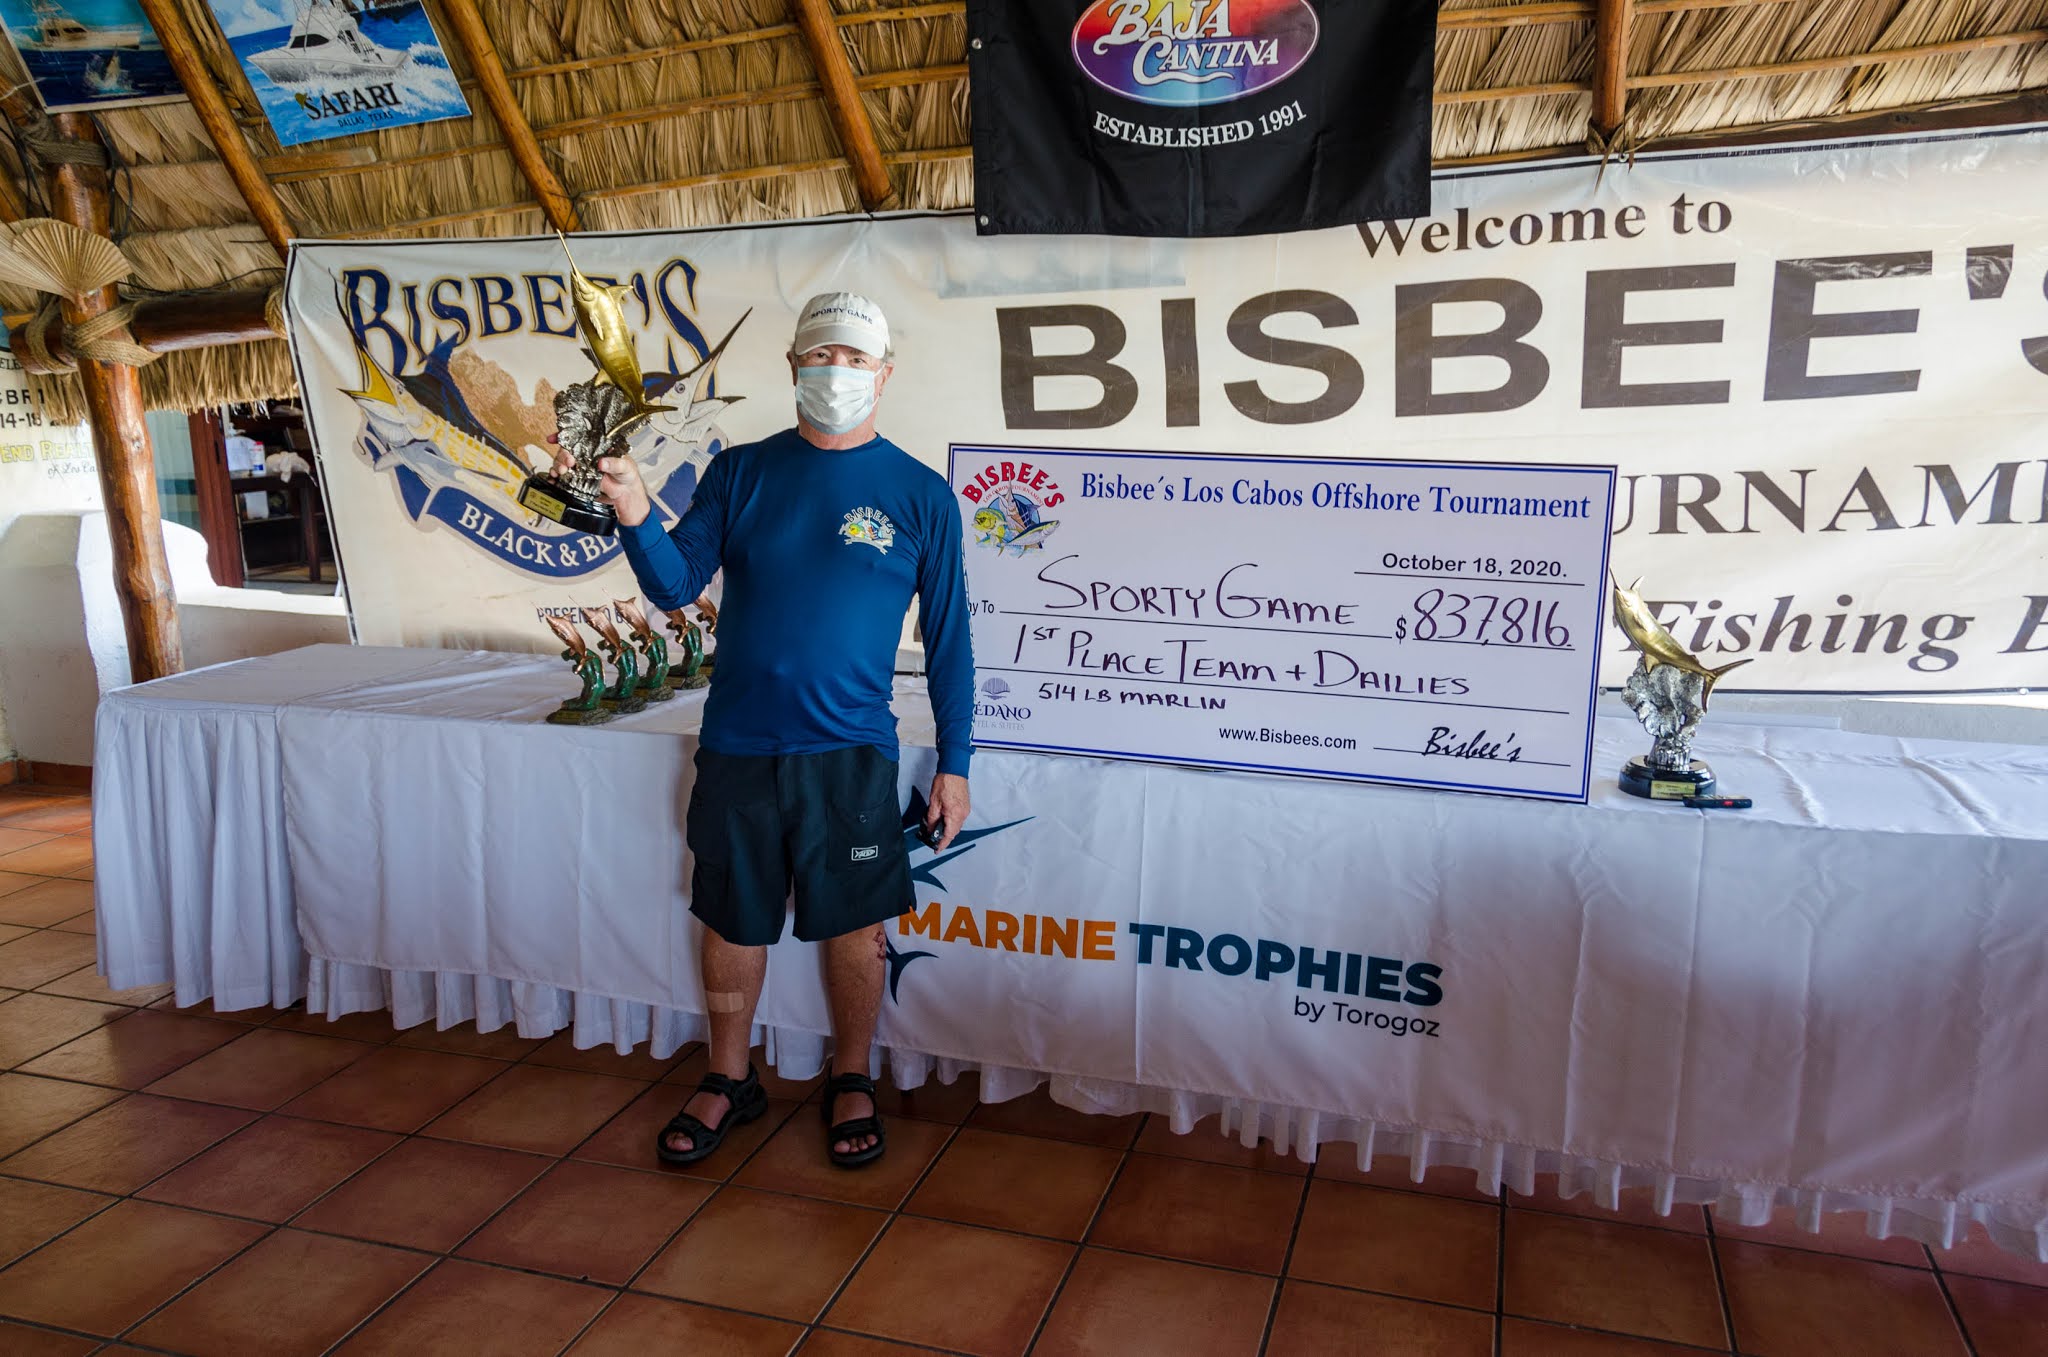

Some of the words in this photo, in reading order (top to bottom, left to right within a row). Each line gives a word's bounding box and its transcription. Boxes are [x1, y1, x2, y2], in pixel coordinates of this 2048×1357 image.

[1093, 0, 1232, 55] BAJA
[1132, 35, 1279, 86] CANTINA
[303, 82, 402, 120] SAFARI
[338, 116, 365, 128] DALLAS
[367, 110, 394, 122] TEXAS
[1093, 110, 1254, 148] ESTABLISHED
[1258, 100, 1307, 136] 1991
[1356, 204, 1646, 259] Welcome
[1671, 193, 1733, 235] to
[343, 257, 720, 399] BISBE'S
[810, 307, 845, 319] SPORTY
[847, 308, 873, 325] GAME
[962, 461, 1065, 508] BISBEE'S
[1182, 477, 1224, 504] Los
[1232, 479, 1303, 508] Cabos
[1312, 481, 1421, 512] Offshore
[1429, 486, 1591, 519] Tournament
[458, 503, 557, 568] BLACK
[559, 543, 579, 568] &
[577, 528, 620, 562] BL
[1382, 552, 1466, 573] October
[1473, 559, 1503, 577] 18,
[1510, 560, 1568, 578] 2020.
[981, 600, 995, 613] To
[1037, 554, 1206, 619] SPORTY
[1215, 563, 1359, 625] GAME
[1618, 594, 1976, 673] Fishing
[1067, 630, 1165, 675] PLACE
[1163, 640, 1277, 684] TEAM
[1313, 649, 1470, 695] DAILIES
[1038, 682, 1075, 702] 514
[1085, 688, 1112, 703] LB
[1120, 691, 1226, 710] MARLIN
[1219, 727, 1357, 751] www.Bisbees.com
[1421, 726, 1522, 763] Bisbee's
[898, 901, 1116, 961] MARINE
[1129, 922, 1444, 1006] TROPHIES
[1294, 996, 1326, 1024] by
[1332, 1002, 1440, 1038] Torogoz
